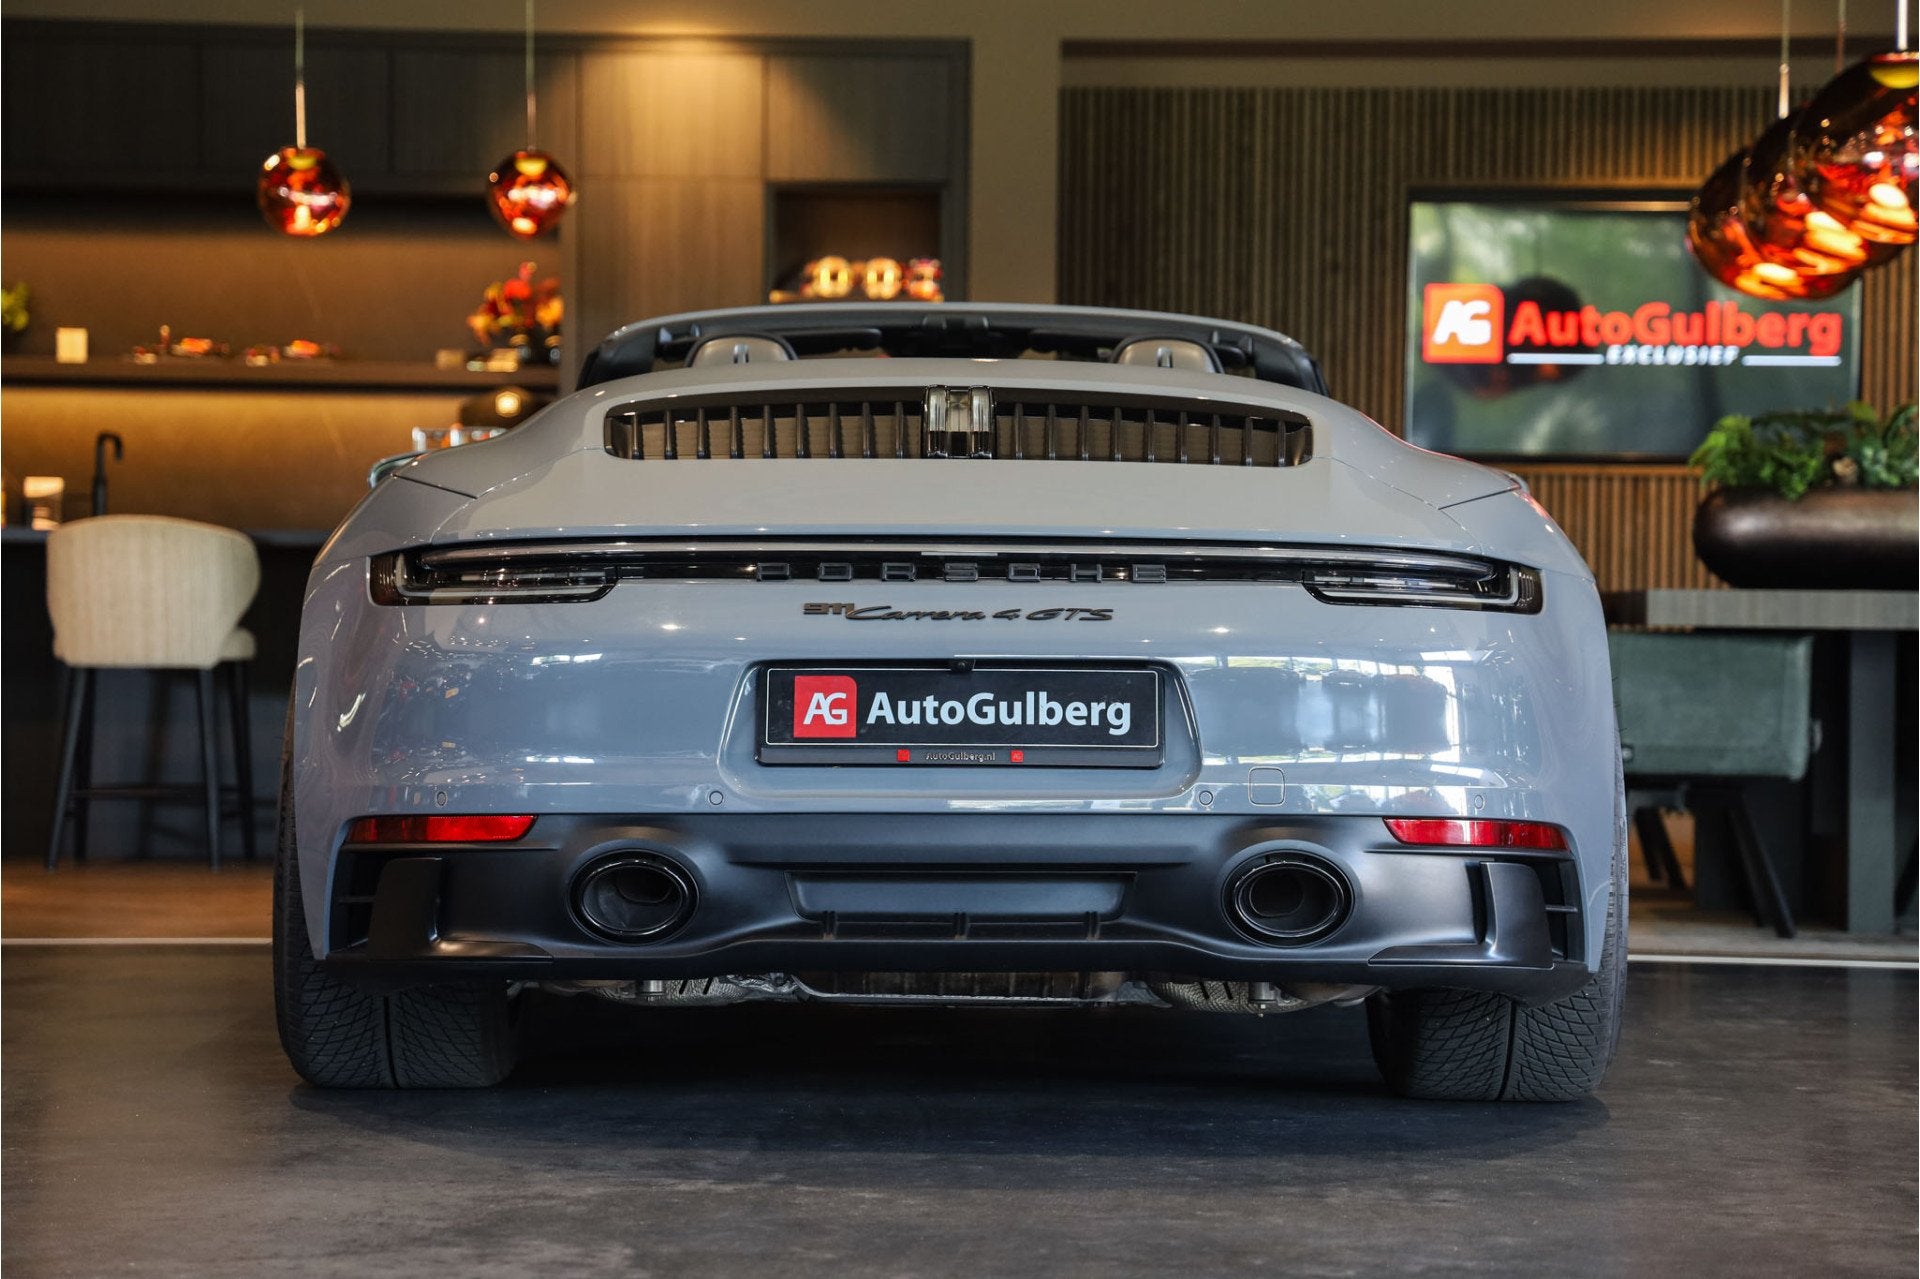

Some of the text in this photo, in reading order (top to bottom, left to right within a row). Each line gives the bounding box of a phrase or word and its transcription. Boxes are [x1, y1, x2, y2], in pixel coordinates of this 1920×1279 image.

[1432, 300, 1842, 356] AG AutoGulberg
[757, 562, 1166, 583] PORSCHE
[803, 603, 1114, 621] 911 Carrera 4 GTS
[803, 691, 1131, 736] AG AutoGulberg
[926, 751, 996, 763] AutoGulberg.nl
